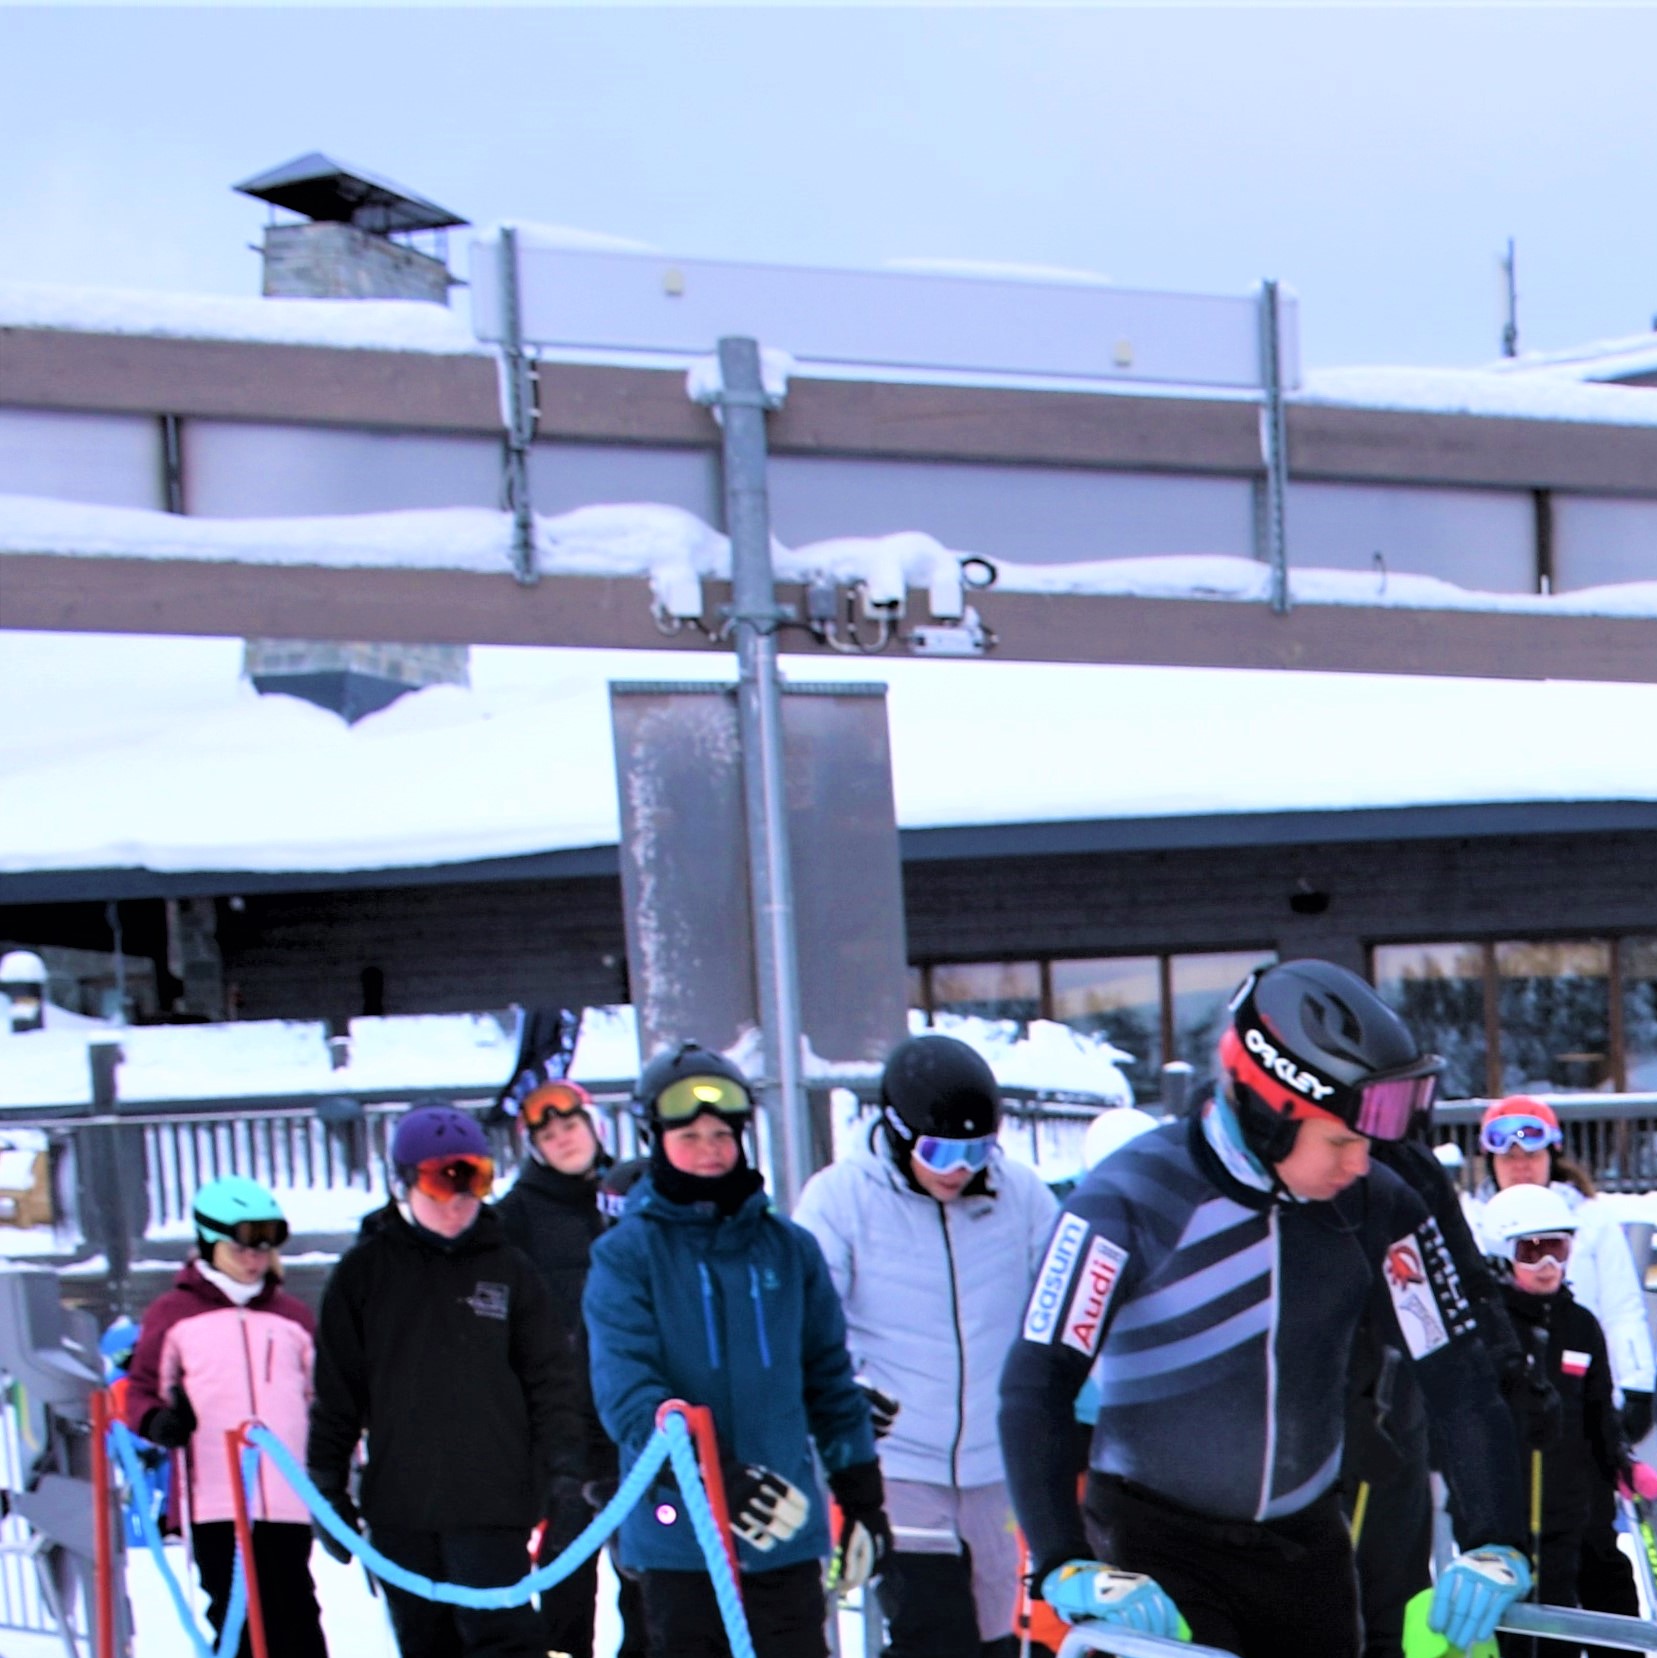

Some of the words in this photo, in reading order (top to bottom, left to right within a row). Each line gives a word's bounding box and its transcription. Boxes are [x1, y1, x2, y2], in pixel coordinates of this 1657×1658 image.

[1244, 1028, 1335, 1100] OAKLEY
[1027, 1222, 1081, 1333] Gasum
[1073, 1259, 1118, 1350] Audi
